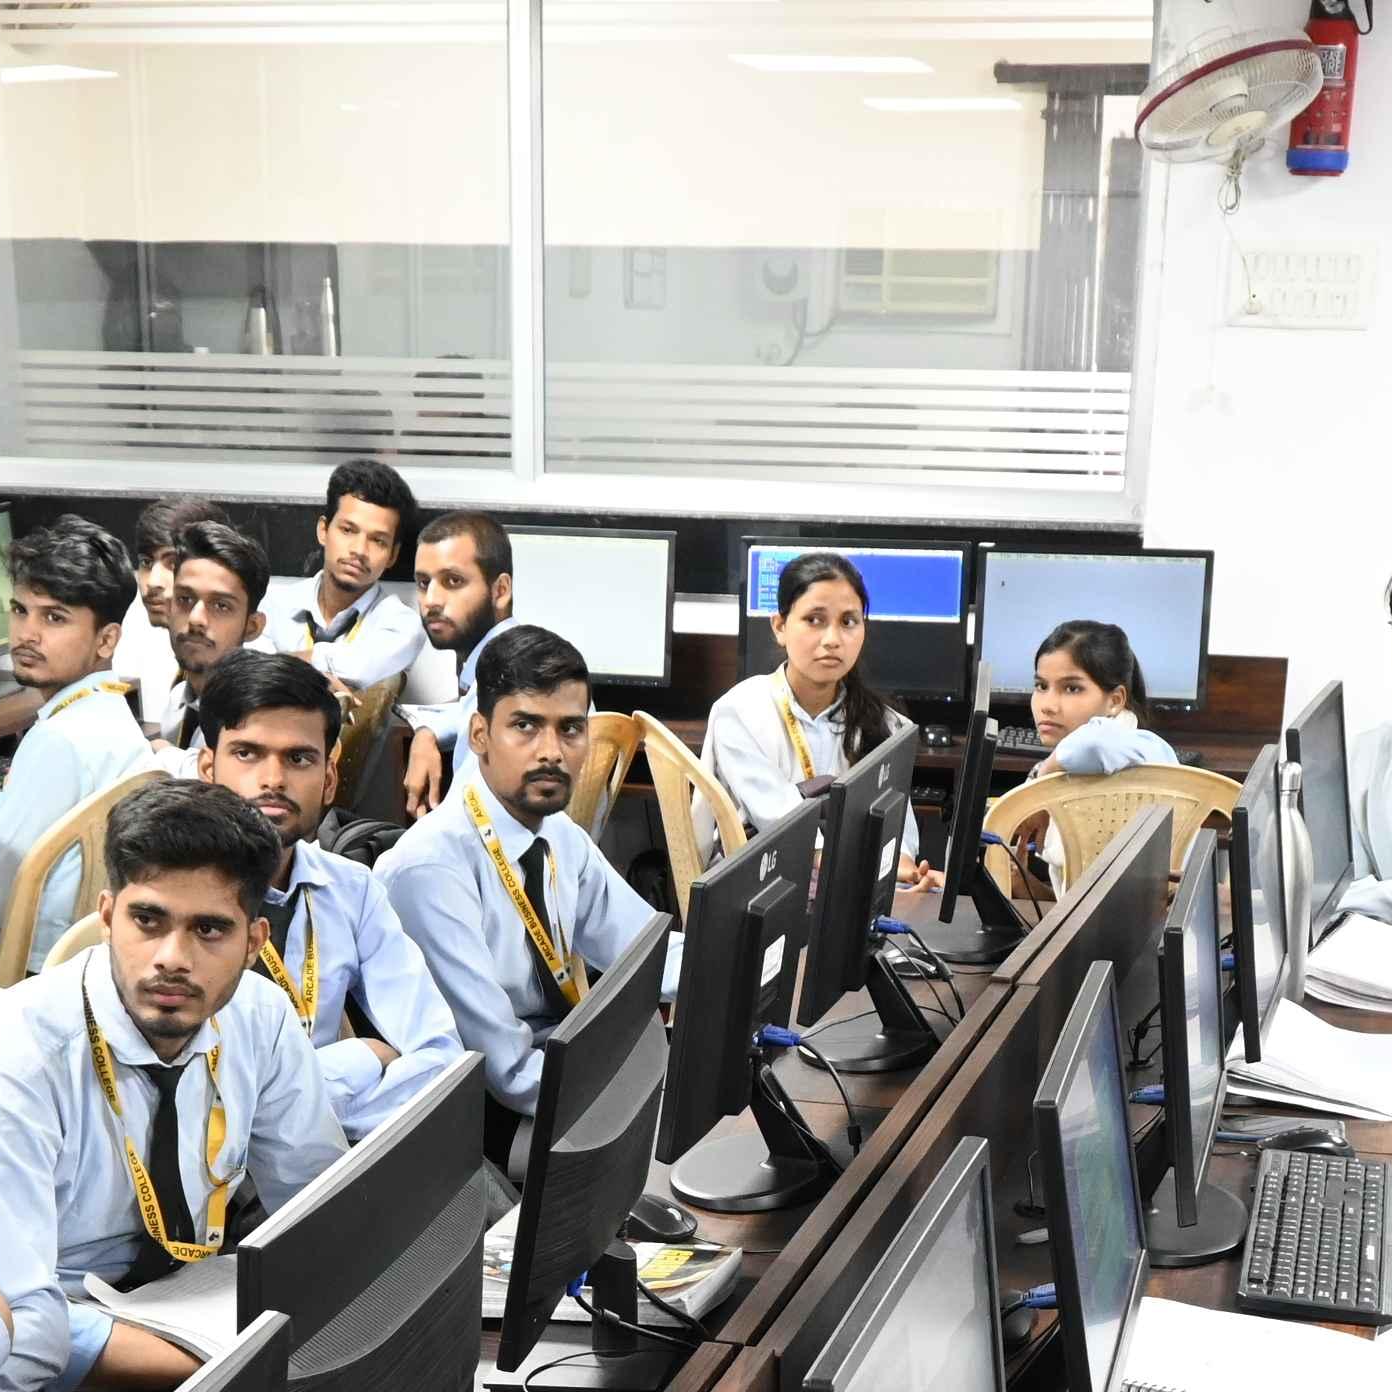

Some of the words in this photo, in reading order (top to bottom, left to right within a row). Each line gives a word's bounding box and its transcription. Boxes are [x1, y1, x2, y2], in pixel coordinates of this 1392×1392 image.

[492, 848, 516, 888] COLLEGE
[511, 889, 539, 928] BUSINESS
[533, 929, 555, 962] ARCADE
[305, 963, 314, 1004] ARCADE
[93, 1046, 116, 1103] COLLEGE
[128, 1151, 152, 1203] COLLEGE
